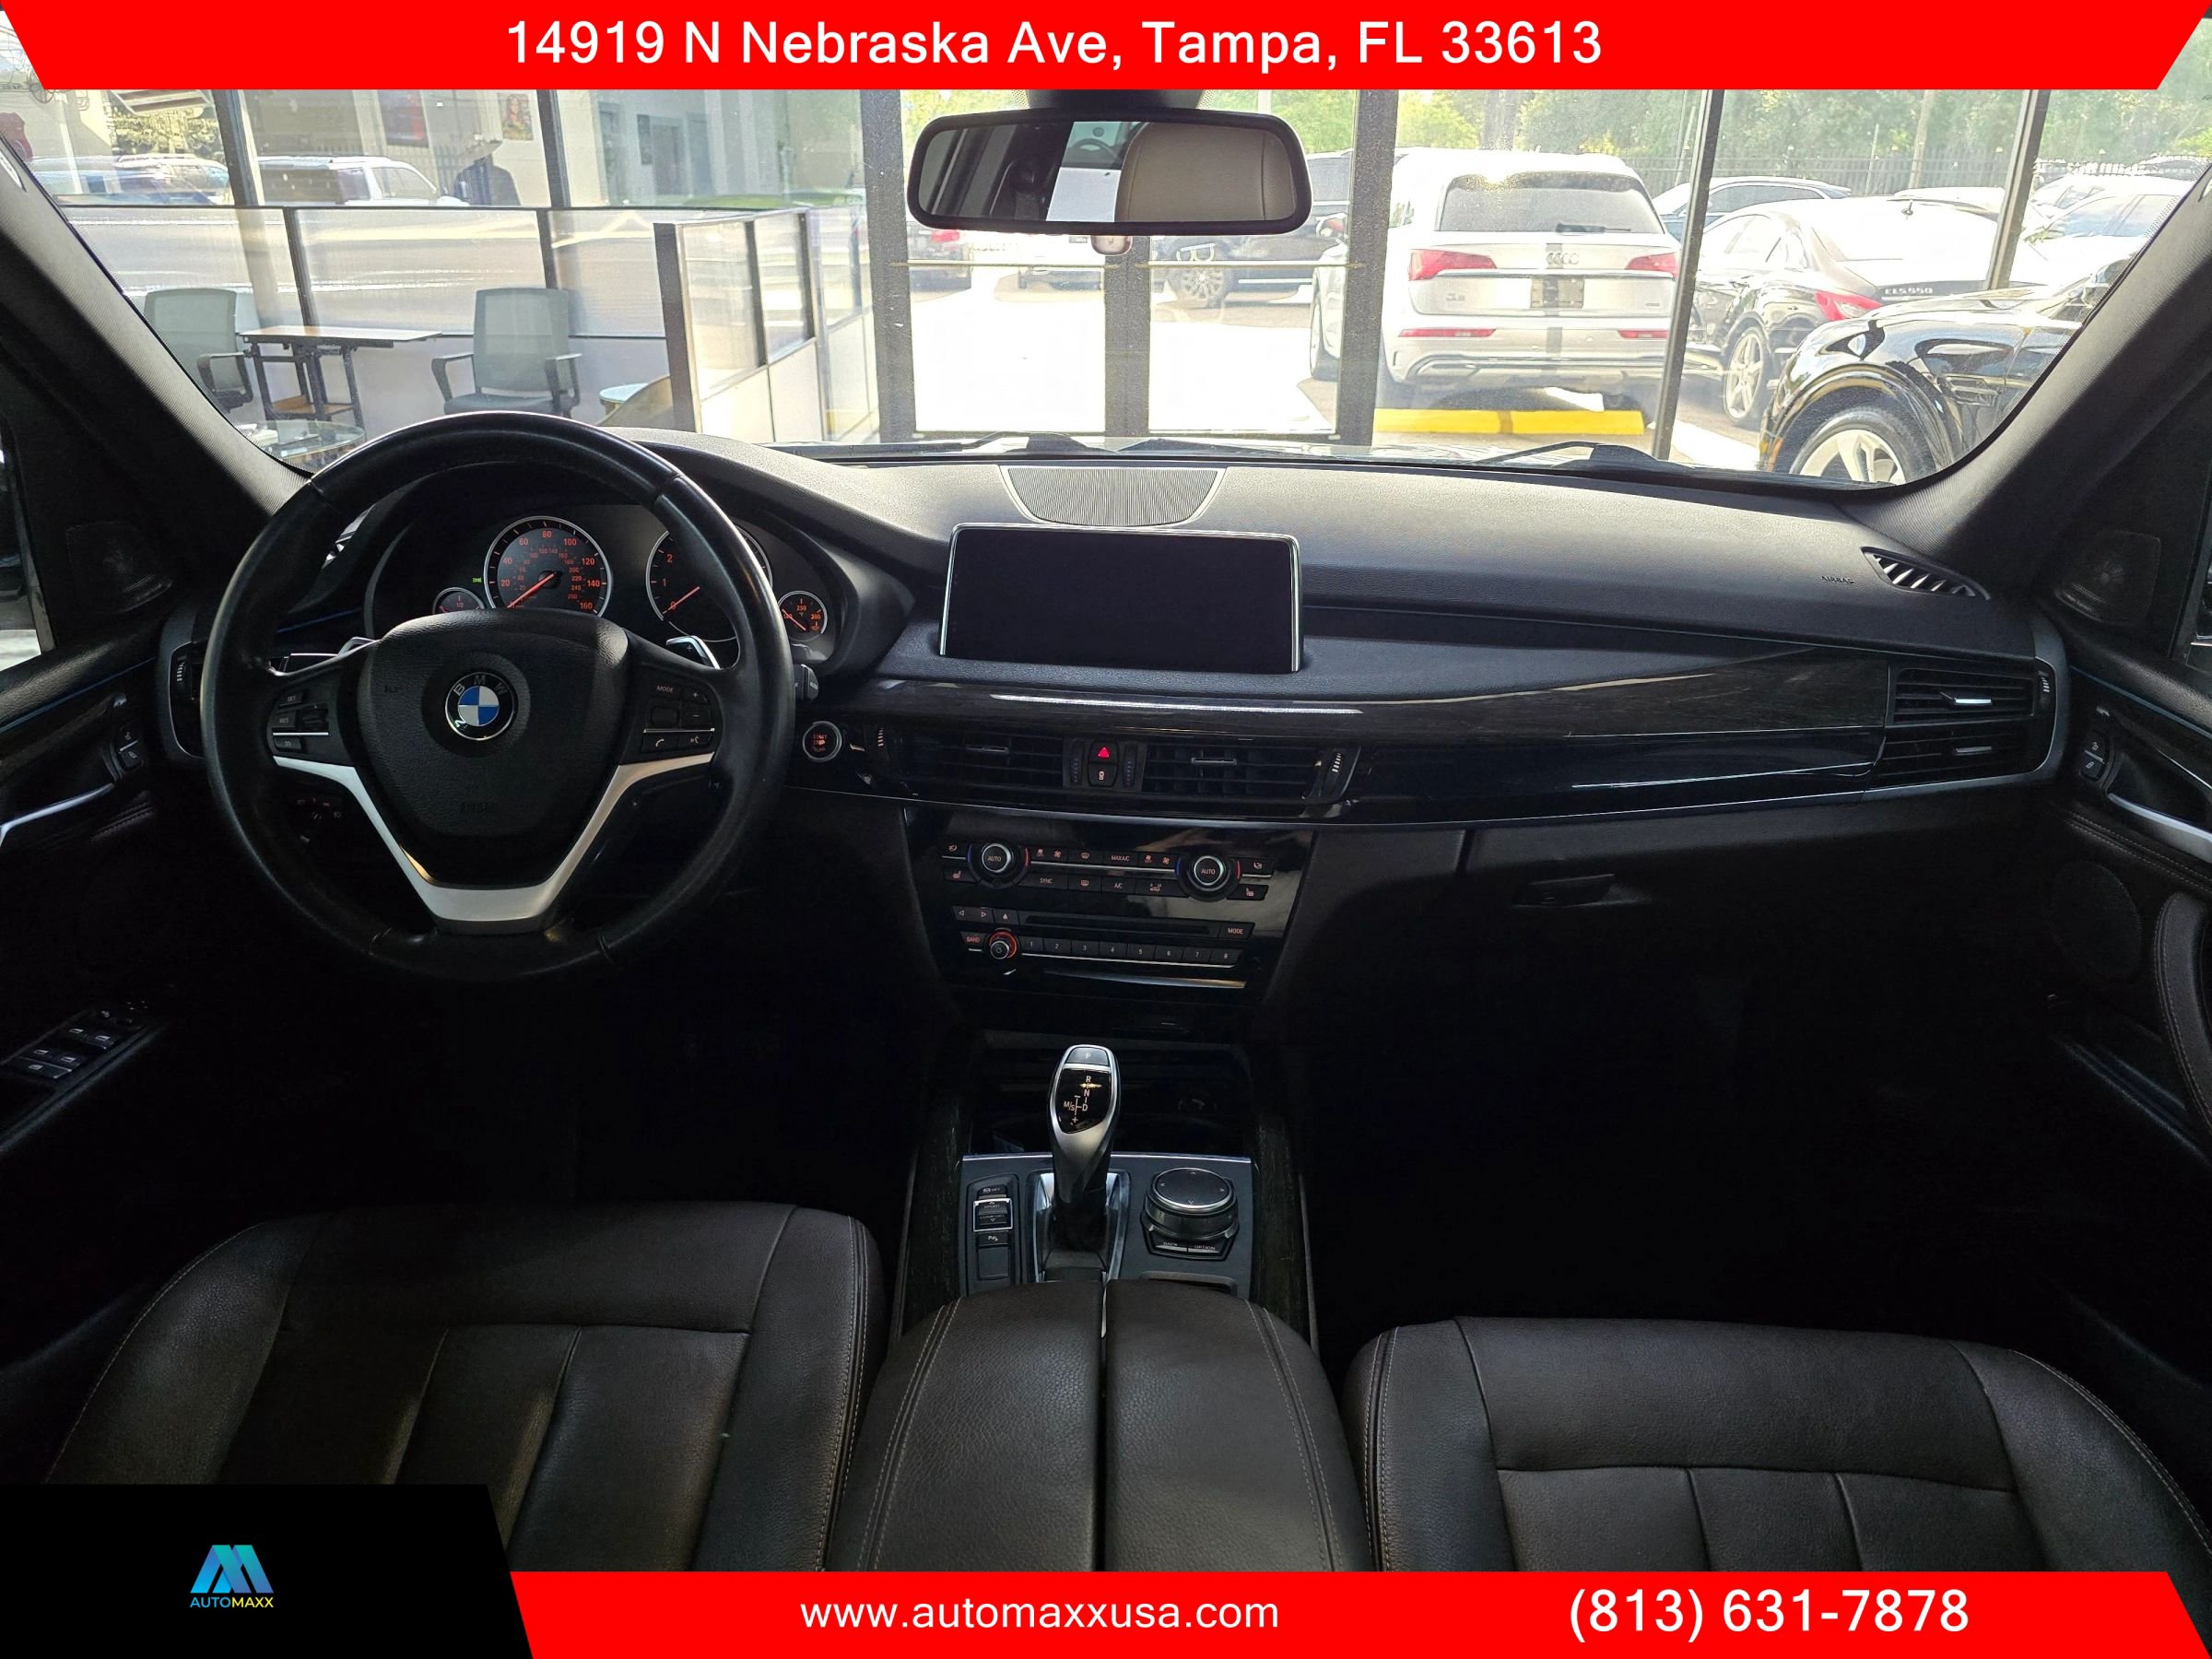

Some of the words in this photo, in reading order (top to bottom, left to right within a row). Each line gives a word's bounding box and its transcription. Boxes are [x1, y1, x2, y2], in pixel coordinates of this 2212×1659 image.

[542, 530, 552, 538] 80
[563, 538, 577, 547] 100
[502, 557, 512, 565] 40
[582, 557, 595, 566] 120
[666, 553, 673, 563] 2
[500, 579, 511, 587] 20
[580, 602, 593, 610] 160
[453, 675, 508, 697] BMW
[656, 685, 674, 693] MODE
[1201, 867, 1216, 876] AUTO
[1228, 926, 1244, 935] MODE
[1063, 1100, 1076, 1112] M/S
[1081, 1103, 1088, 1112] D
